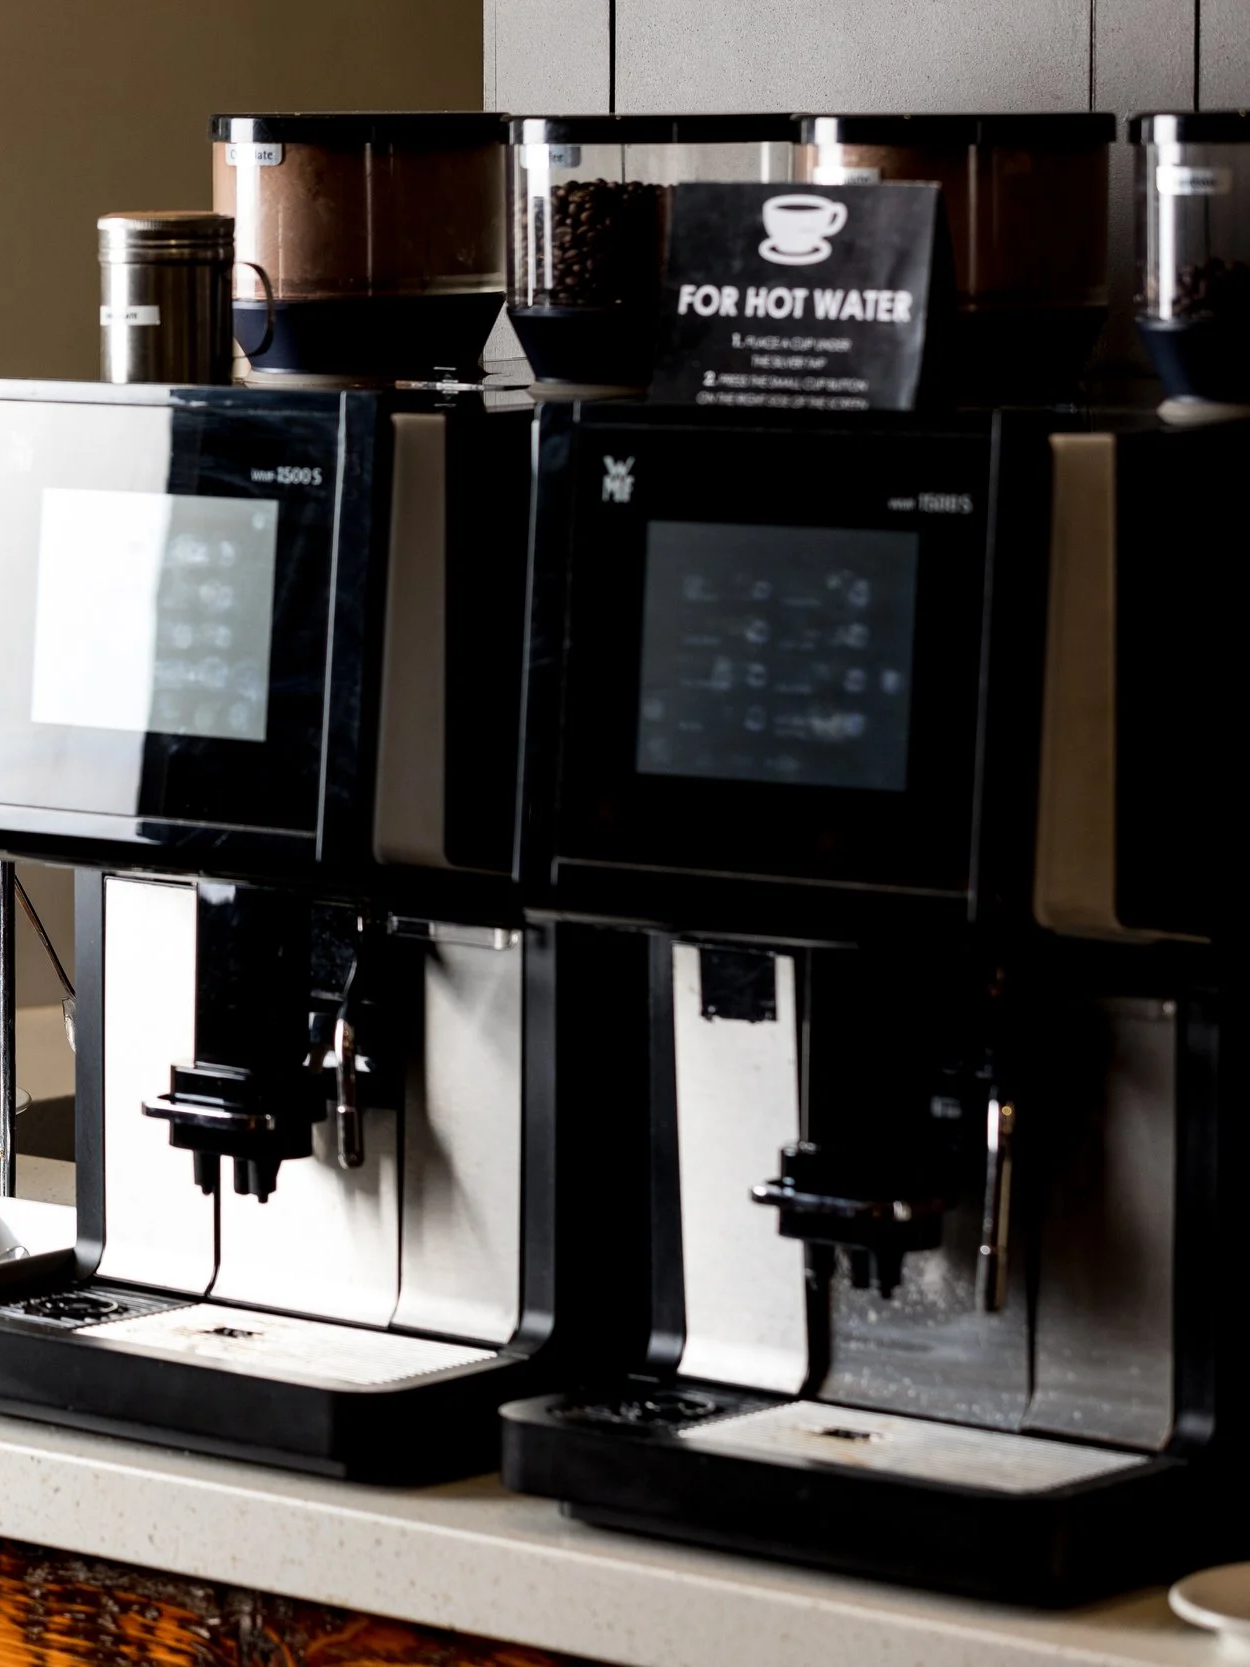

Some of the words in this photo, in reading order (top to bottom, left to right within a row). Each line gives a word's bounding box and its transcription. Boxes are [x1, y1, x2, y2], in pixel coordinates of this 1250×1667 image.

[677, 284, 740, 317] FOR
[745, 286, 810, 319] HOT
[814, 288, 914, 323] WATER
